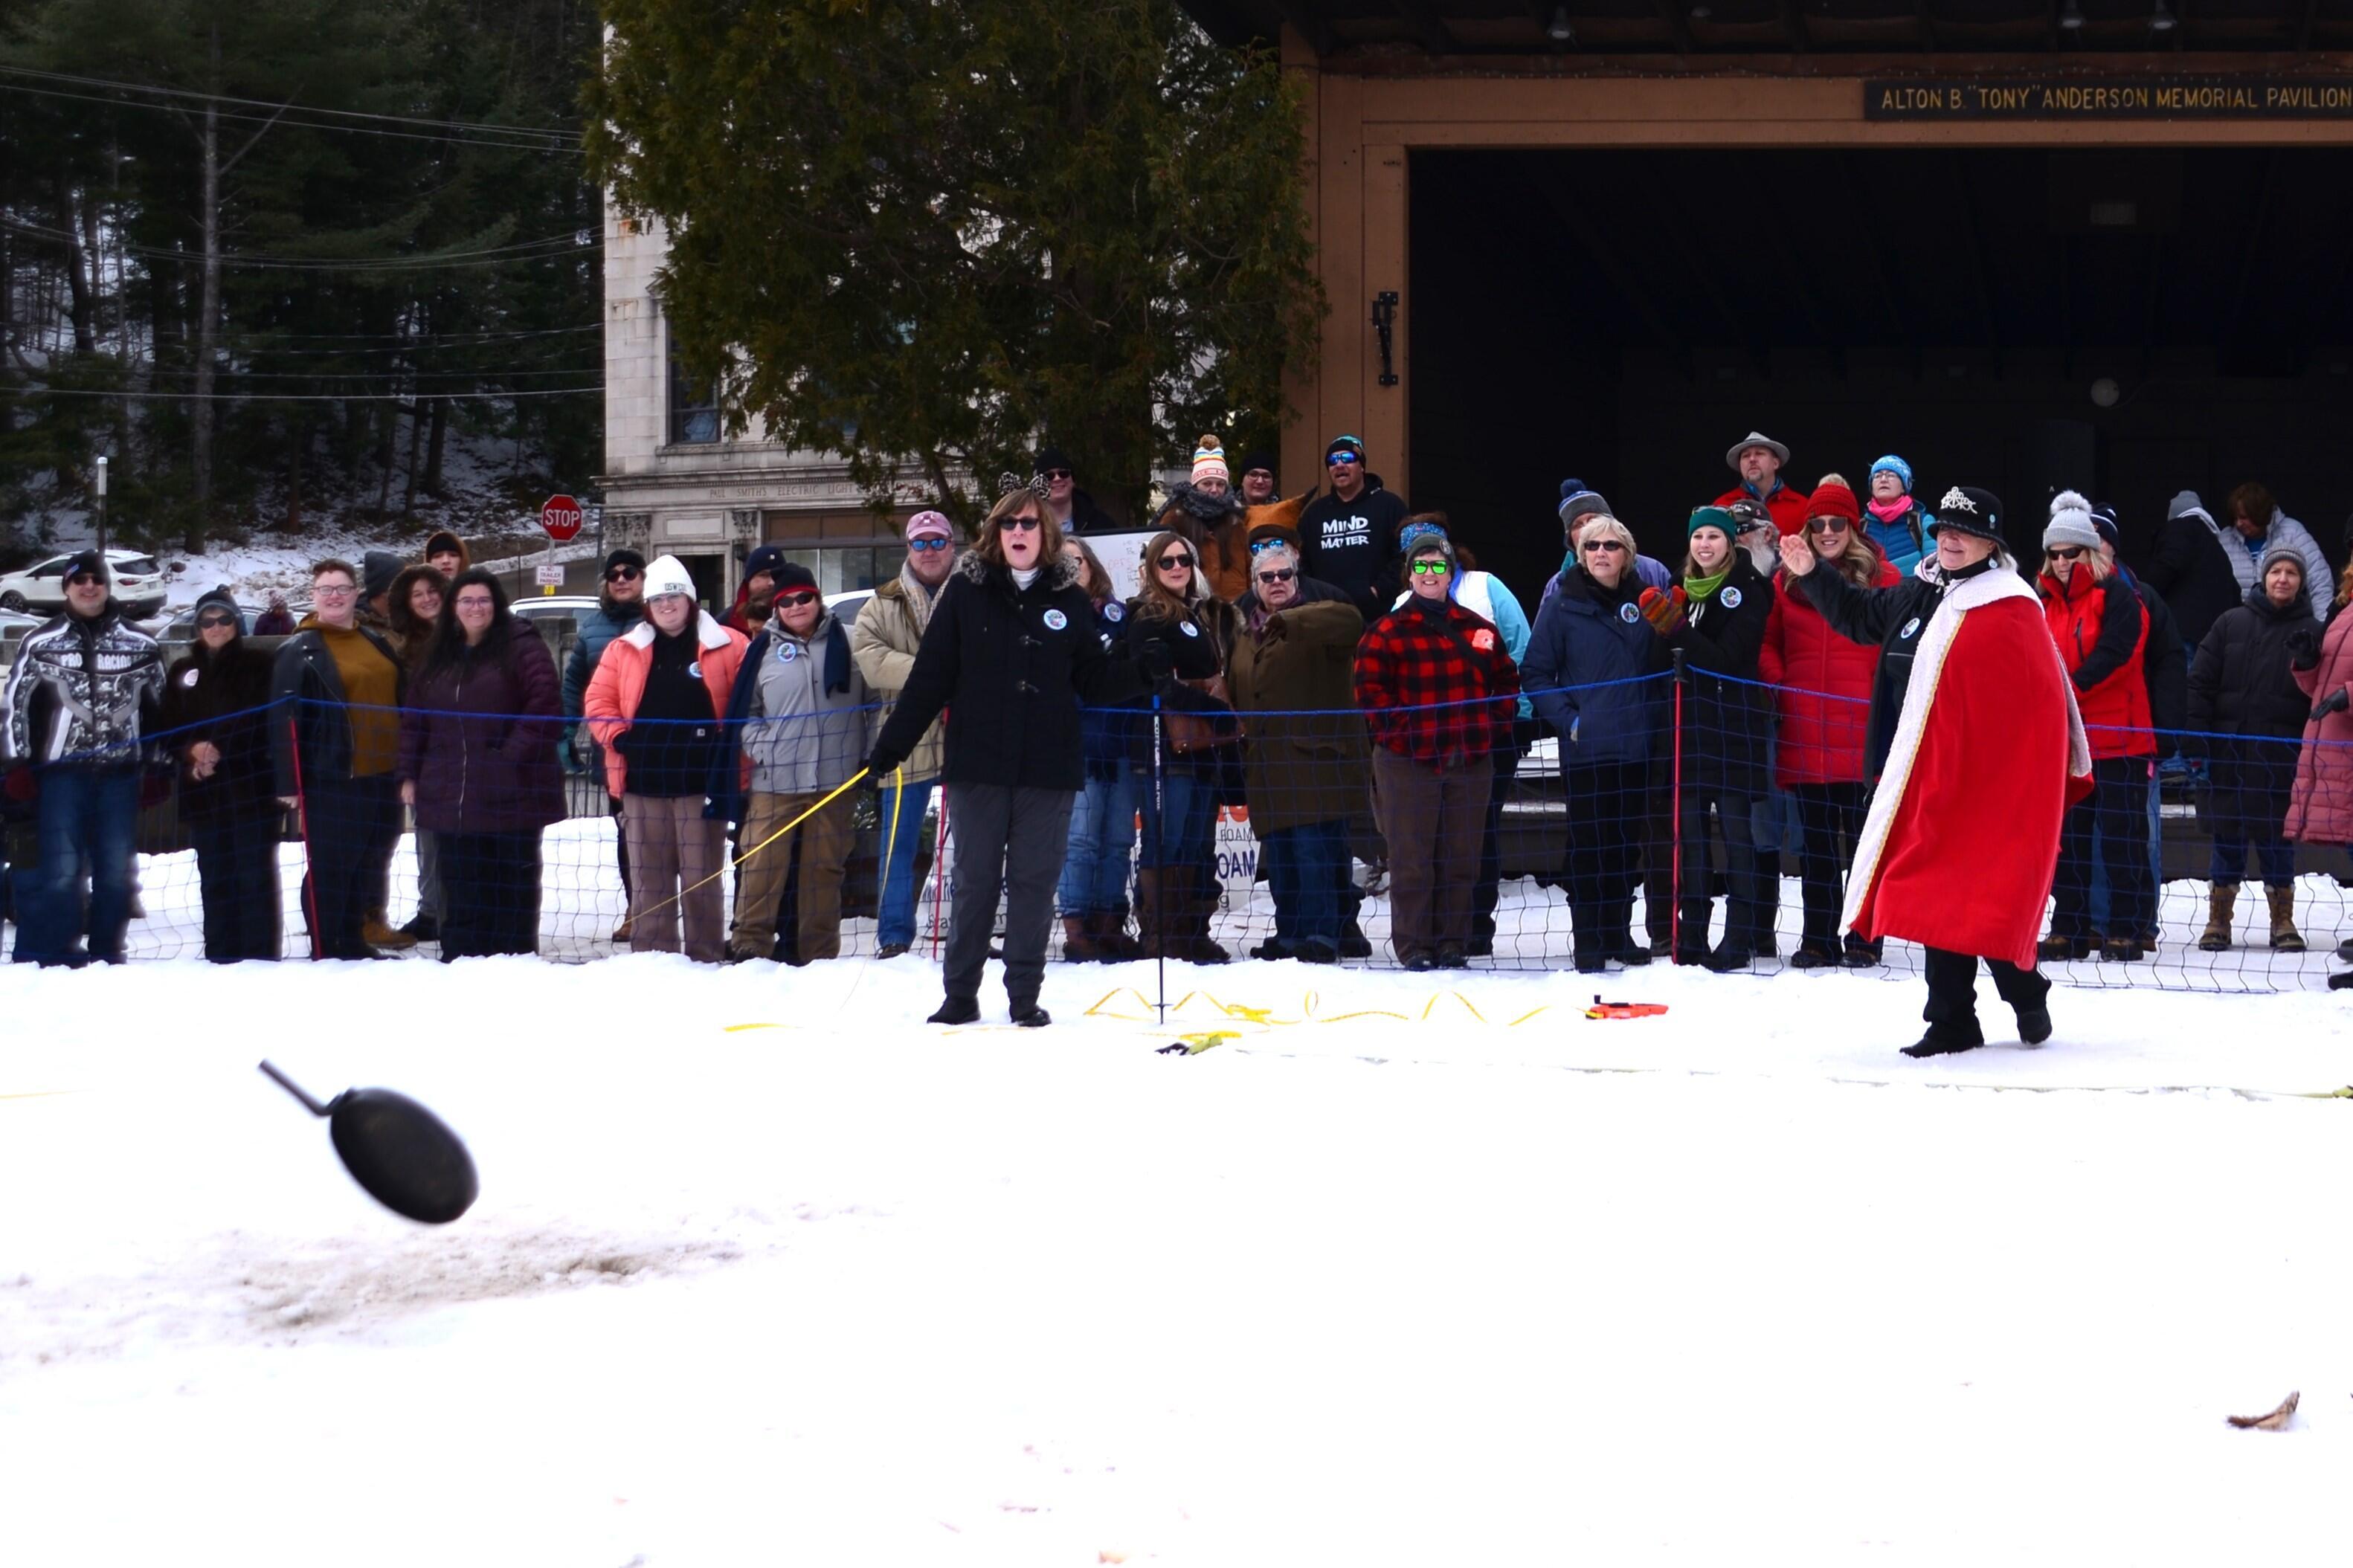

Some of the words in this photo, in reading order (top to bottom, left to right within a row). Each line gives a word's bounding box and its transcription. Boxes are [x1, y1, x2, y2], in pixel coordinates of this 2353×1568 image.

[1882, 88, 1942, 109] ALTON
[2042, 87, 2148, 109] ANDERSON
[2157, 87, 2258, 109] MEMORIAL
[2267, 87, 2353, 108] PAVILION
[778, 485, 819, 496] ELECTRIC
[828, 483, 853, 494] LIGHT
[545, 509, 580, 527] STOP
[1322, 514, 1369, 534] MIND
[1321, 535, 1369, 550] MATTER
[60, 652, 83, 668] PRO
[97, 652, 132, 670] RACING
